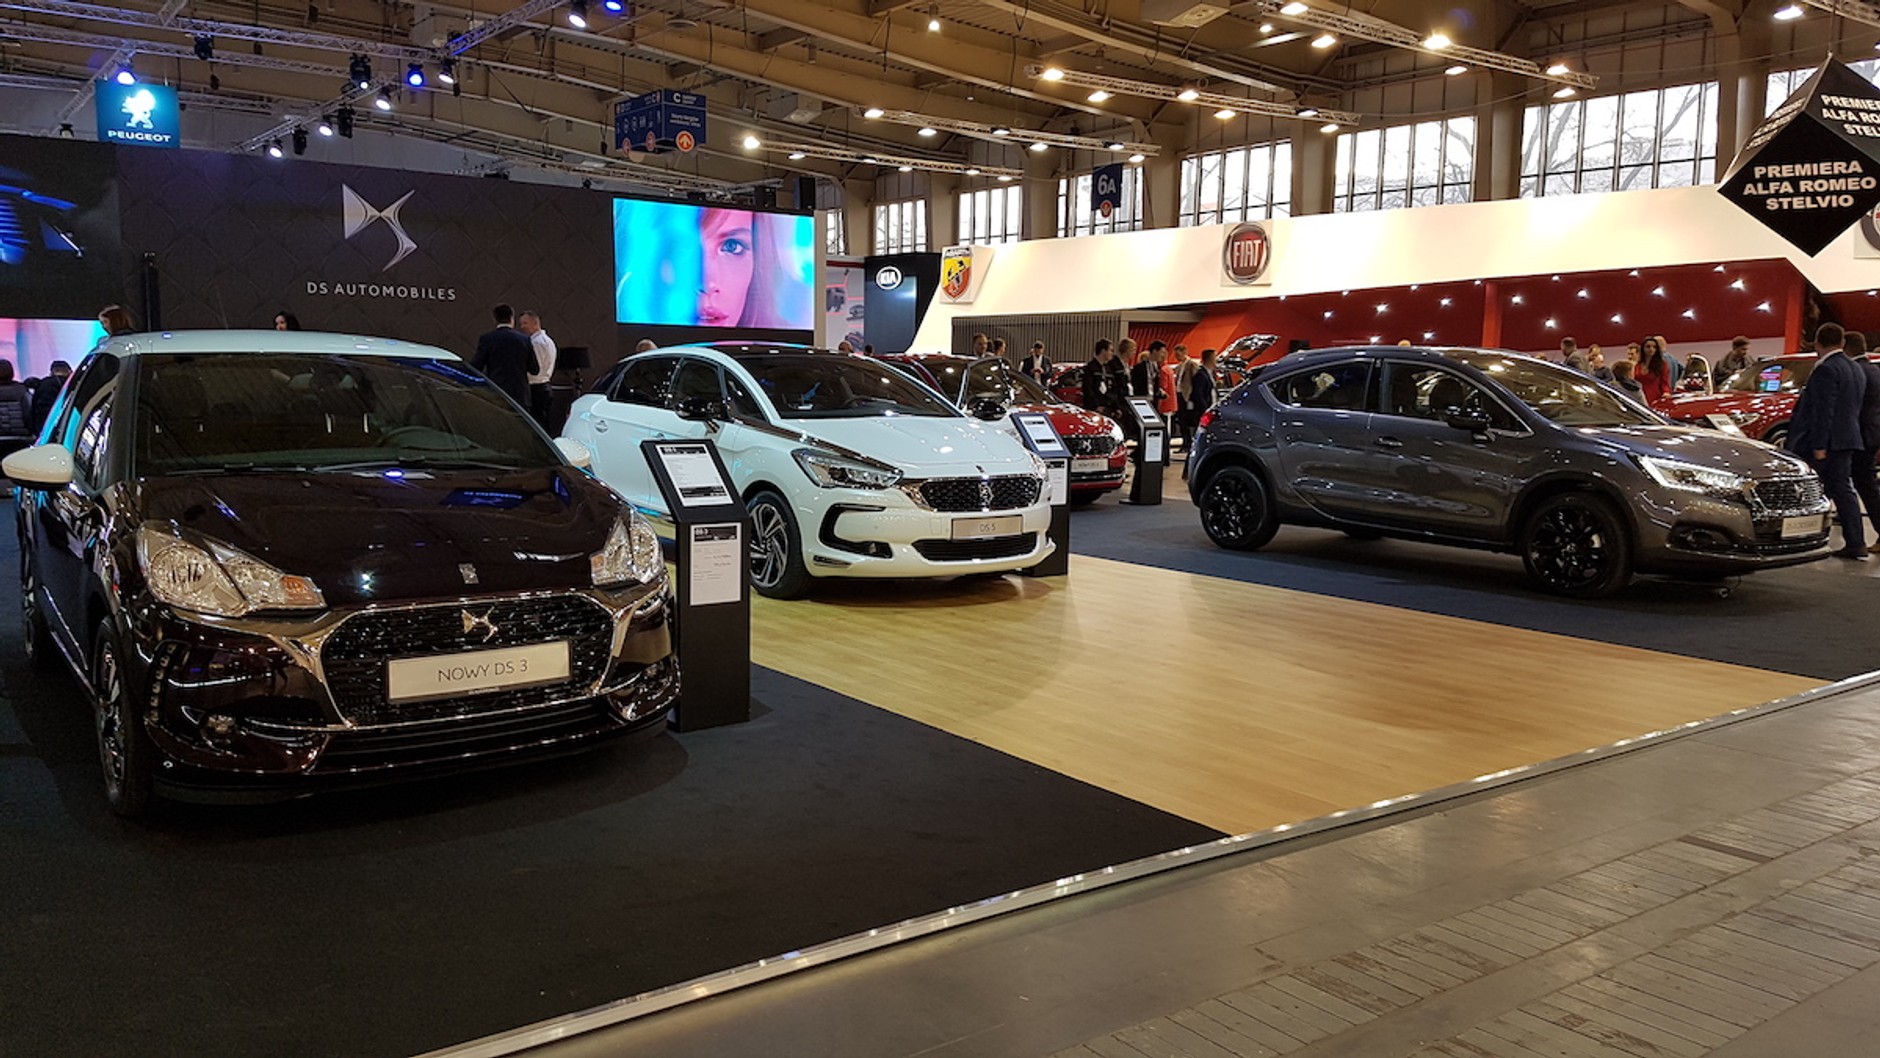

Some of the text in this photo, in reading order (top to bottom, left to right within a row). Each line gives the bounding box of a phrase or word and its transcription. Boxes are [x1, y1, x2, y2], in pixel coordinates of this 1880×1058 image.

[673, 92, 681, 103] C
[1822, 108, 1860, 121] ALFA
[107, 130, 172, 142] PEUGEOT
[1843, 123, 1880, 137] STEL
[1753, 160, 1863, 179] PREMIERA
[1097, 173, 1117, 195] 6A
[1742, 176, 1877, 196] ALFA ROMEO
[1766, 194, 1855, 210] STELVIO
[1233, 239, 1263, 268] FIAT
[880, 271, 896, 285] KIA
[306, 281, 456, 300] DS AUTOMOBILES
[438, 659, 528, 682] NOWY DS 3
